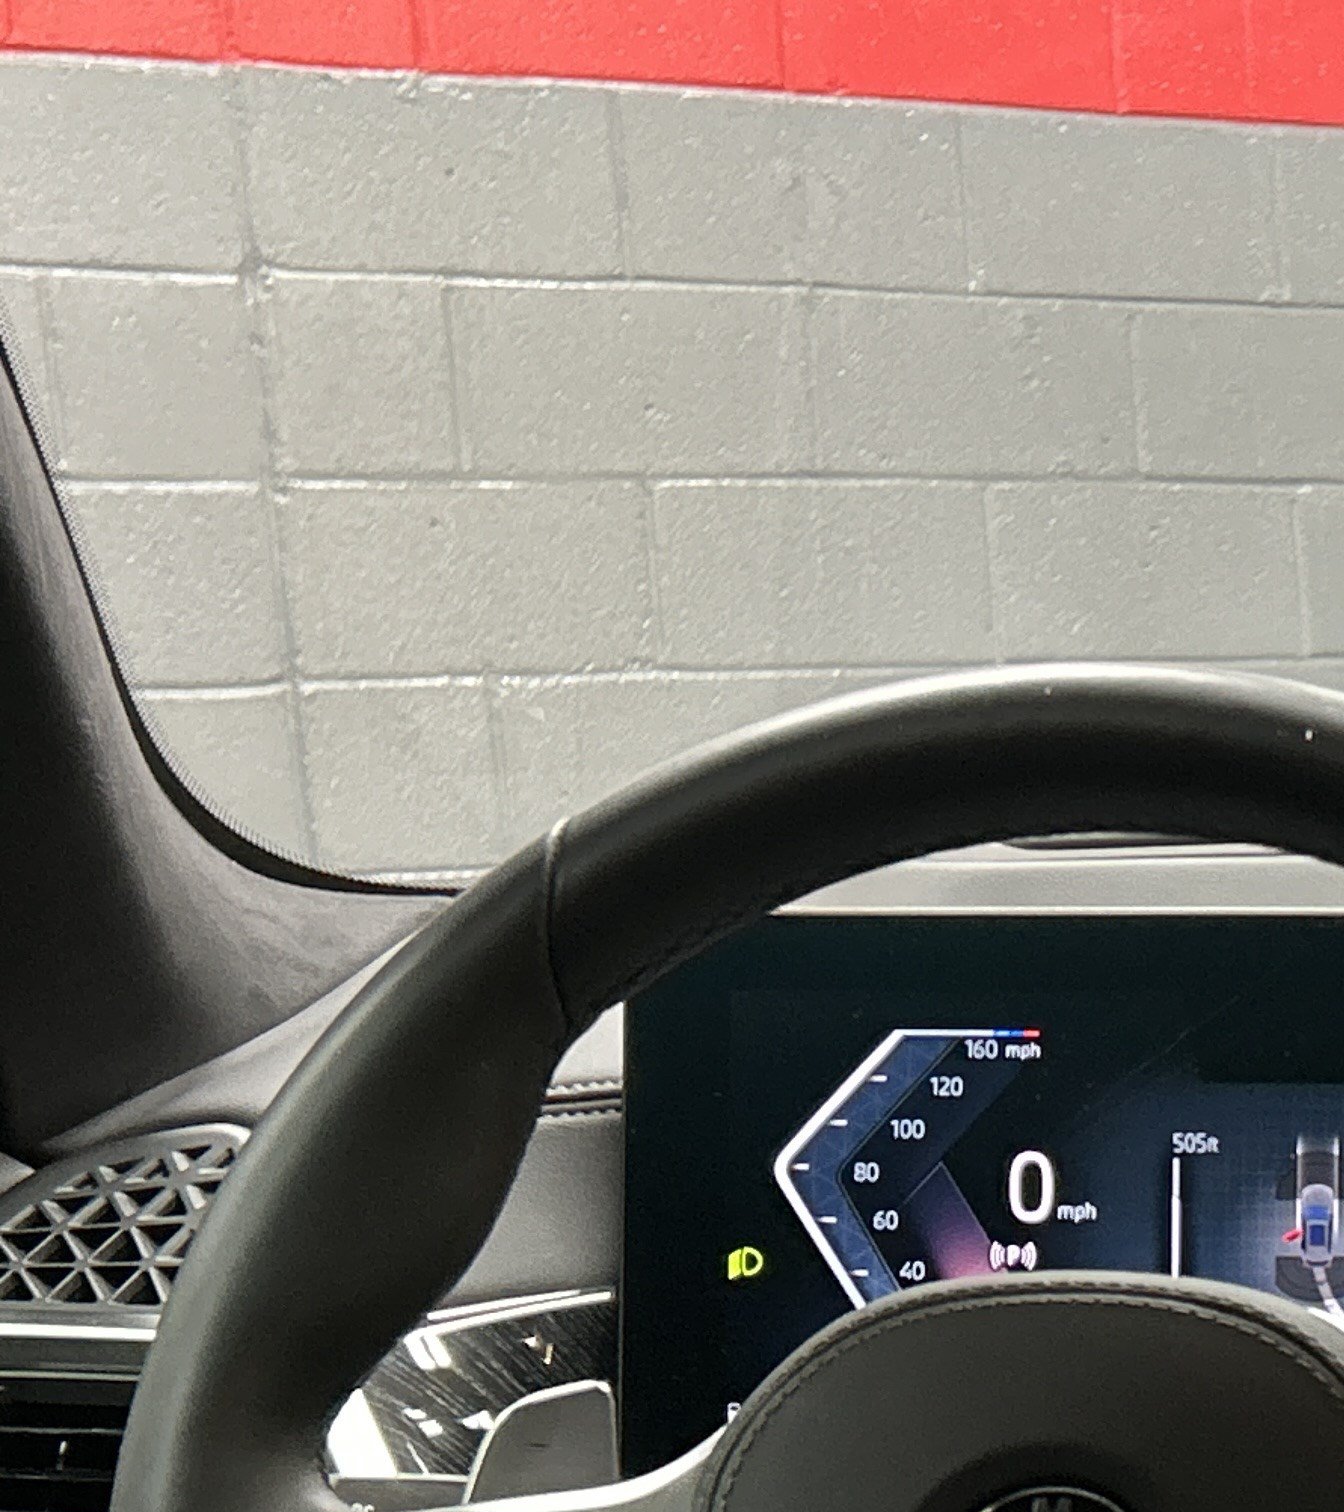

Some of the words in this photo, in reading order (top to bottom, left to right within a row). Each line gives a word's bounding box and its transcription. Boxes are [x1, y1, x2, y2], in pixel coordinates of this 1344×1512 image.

[964, 1038, 998, 1060] 160
[1004, 1041, 1042, 1061] mph
[929, 1075, 964, 1097] 120
[890, 1118, 926, 1140] 100
[853, 1161, 880, 1183] 80
[1008, 1149, 1056, 1224] 0
[1057, 1201, 1098, 1223] mph
[872, 1209, 899, 1231] 60
[899, 1260, 926, 1282] 40
